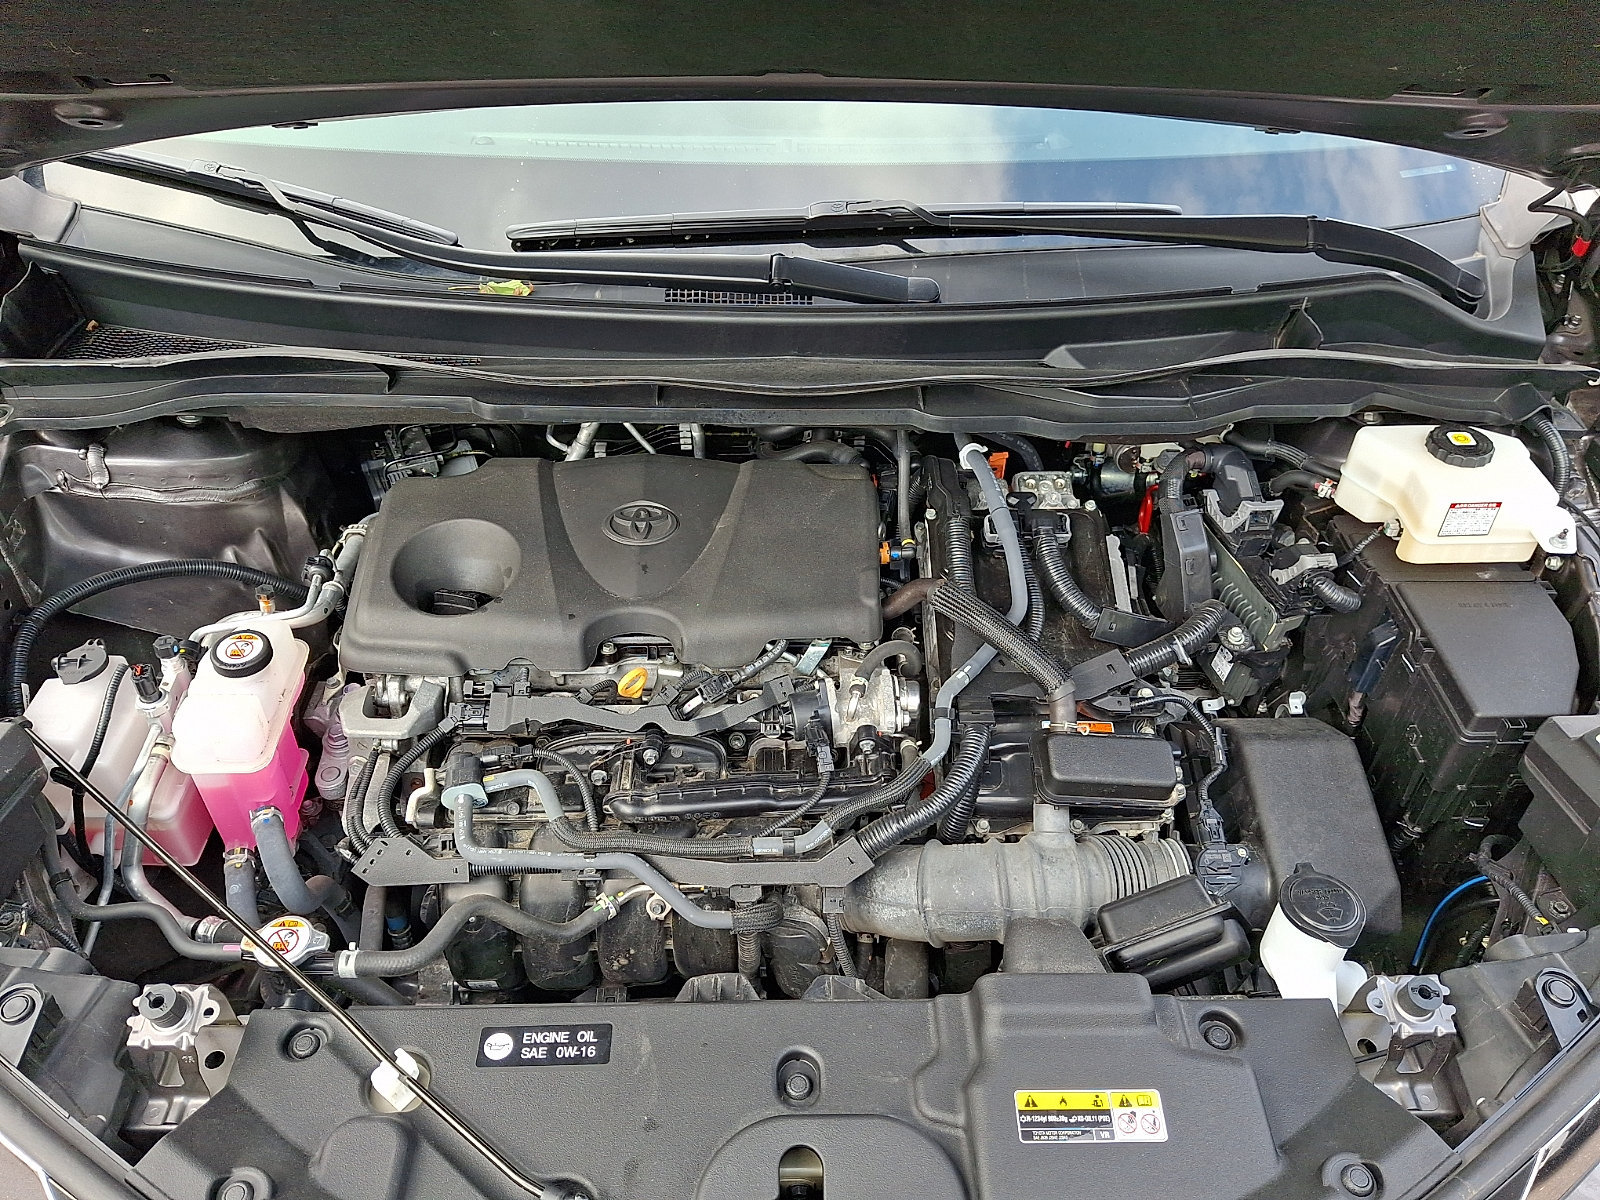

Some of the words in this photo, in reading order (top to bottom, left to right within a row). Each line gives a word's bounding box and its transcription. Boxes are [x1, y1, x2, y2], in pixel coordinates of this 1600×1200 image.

[522, 1031, 570, 1044] ENGINE
[576, 1030, 598, 1043] OIL
[520, 1047, 547, 1059] SAE
[555, 1046, 596, 1058] 0W-16
